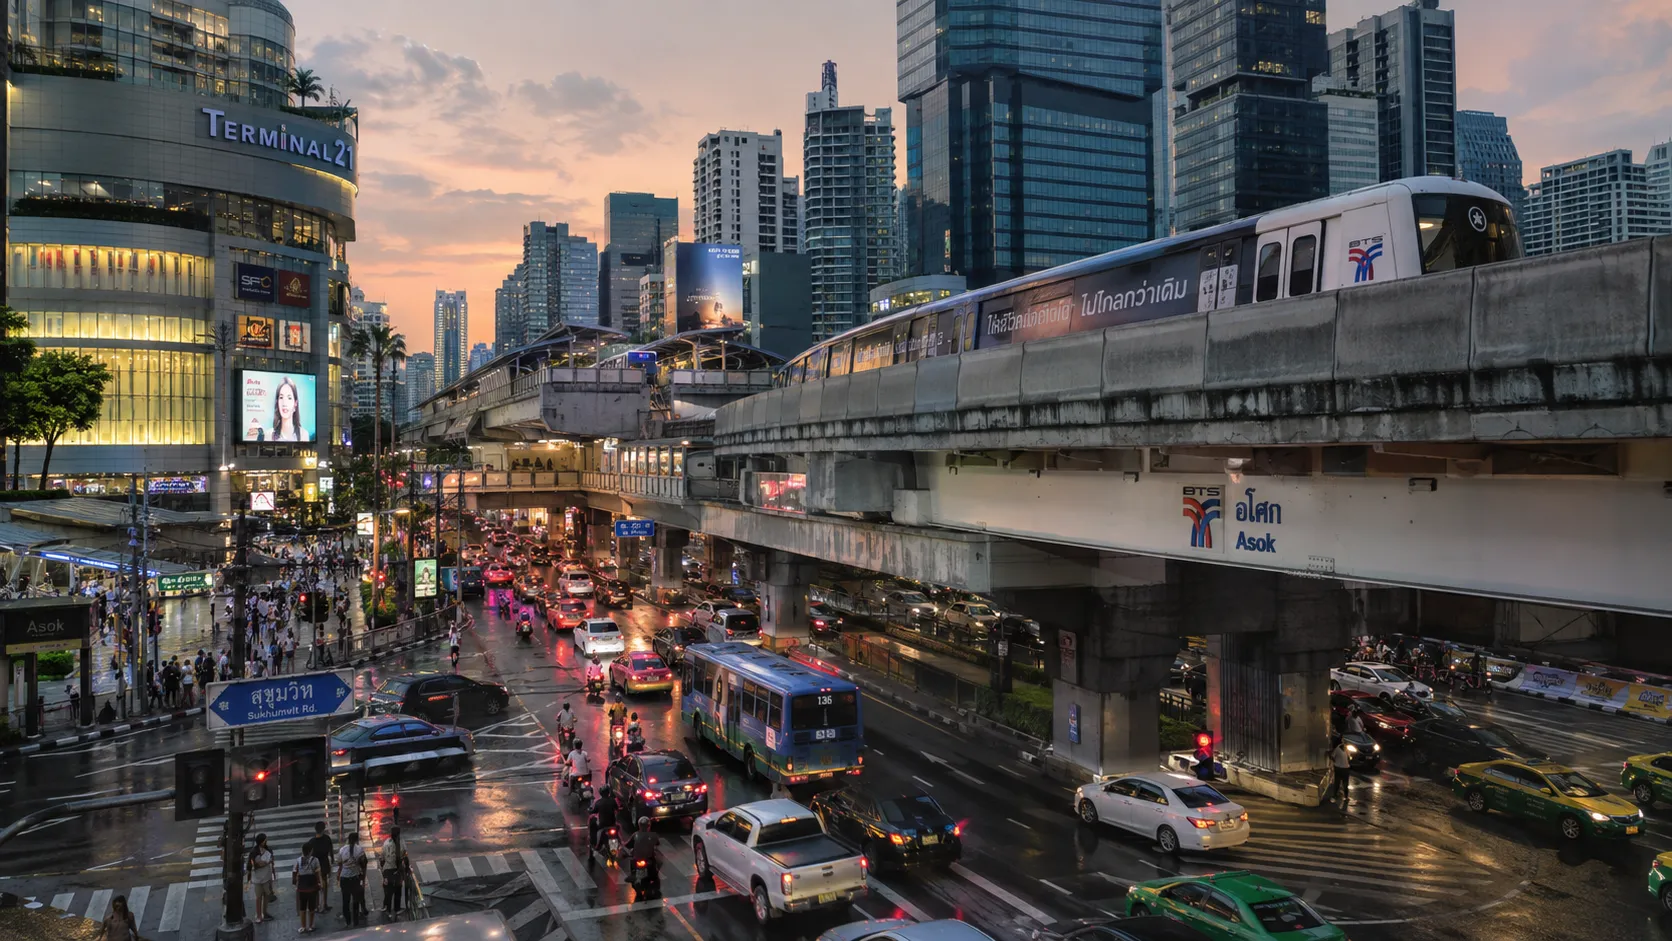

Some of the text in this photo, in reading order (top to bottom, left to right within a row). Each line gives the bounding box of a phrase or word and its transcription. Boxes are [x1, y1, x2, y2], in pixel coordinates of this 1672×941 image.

[1183, 486, 1221, 496] BTS
[1236, 488, 1282, 524] อโศก
[1236, 531, 1277, 553] Asok
[27, 618, 65, 633] Asok
[817, 695, 833, 705] 136
[302, 703, 318, 713] Rd.
